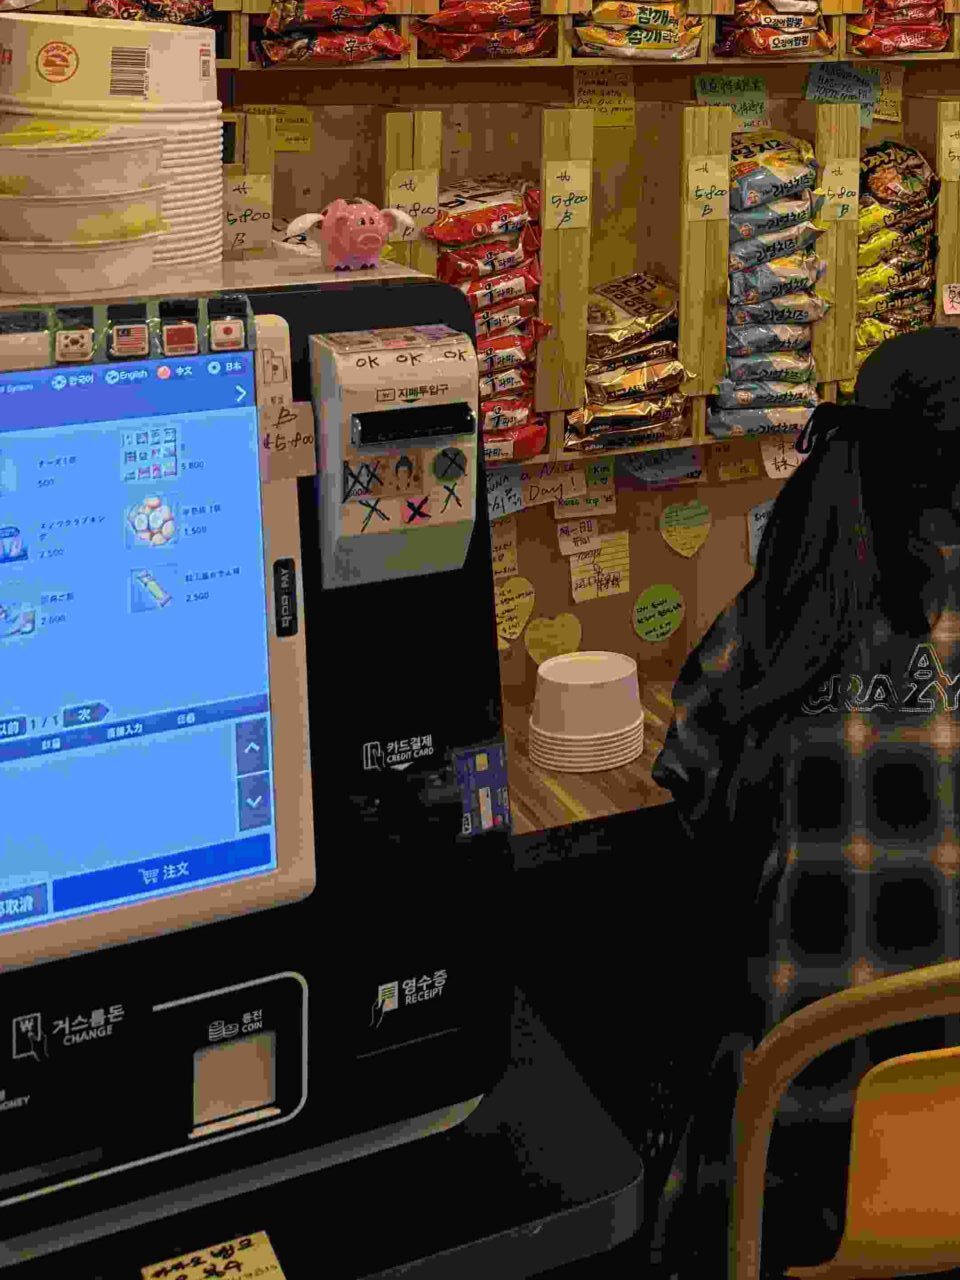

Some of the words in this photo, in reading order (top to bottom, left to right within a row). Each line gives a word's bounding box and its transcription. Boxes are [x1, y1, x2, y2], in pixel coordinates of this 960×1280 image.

[356, 355, 380, 368] OK
[396, 352, 422, 366] OK
[444, 349, 468, 361] OK
[120, 370, 148, 381] English
[176, 366, 193, 377] 中文
[387, 734, 433, 754] 카드결제
[387, 751, 412, 763] CREDIT
[414, 746, 434, 758] CARD
[163, 861, 189, 881] 注文
[402, 969, 448, 997] 영수증
[405, 986, 444, 1006] RECEIPT
[242, 1020, 264, 1034] COIN
[63, 1024, 113, 1047] CHANGE
